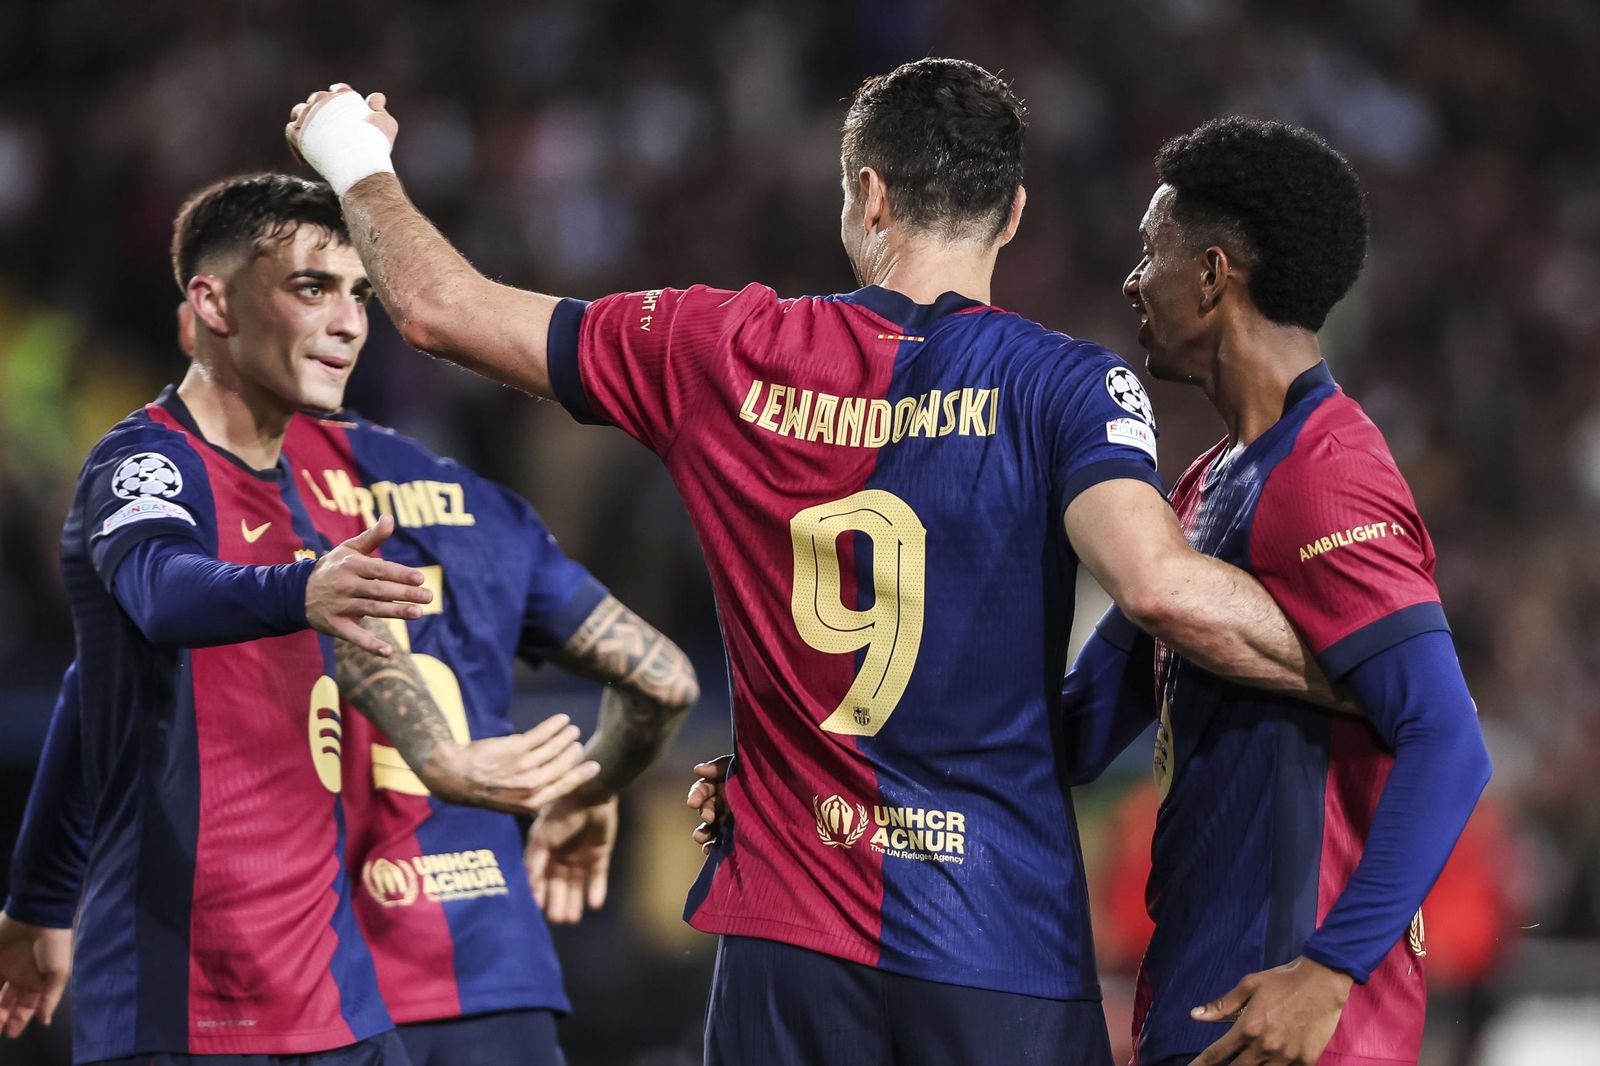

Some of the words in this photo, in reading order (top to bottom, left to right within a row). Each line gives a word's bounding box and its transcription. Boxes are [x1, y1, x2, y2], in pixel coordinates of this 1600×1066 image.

[640, 315, 653, 331] tv
[739, 379, 999, 448] LEWANDOWSKI
[1299, 521, 1387, 563] AMBILIGHT
[789, 489, 927, 737] 9
[873, 804, 966, 833] UNHCR
[869, 827, 966, 855] ACNUR
[870, 844, 886, 855] The
[886, 848, 901, 858] UN
[932, 852, 965, 866] Agency
[411, 848, 499, 876] UNHCR
[422, 866, 507, 895] ACNUR
